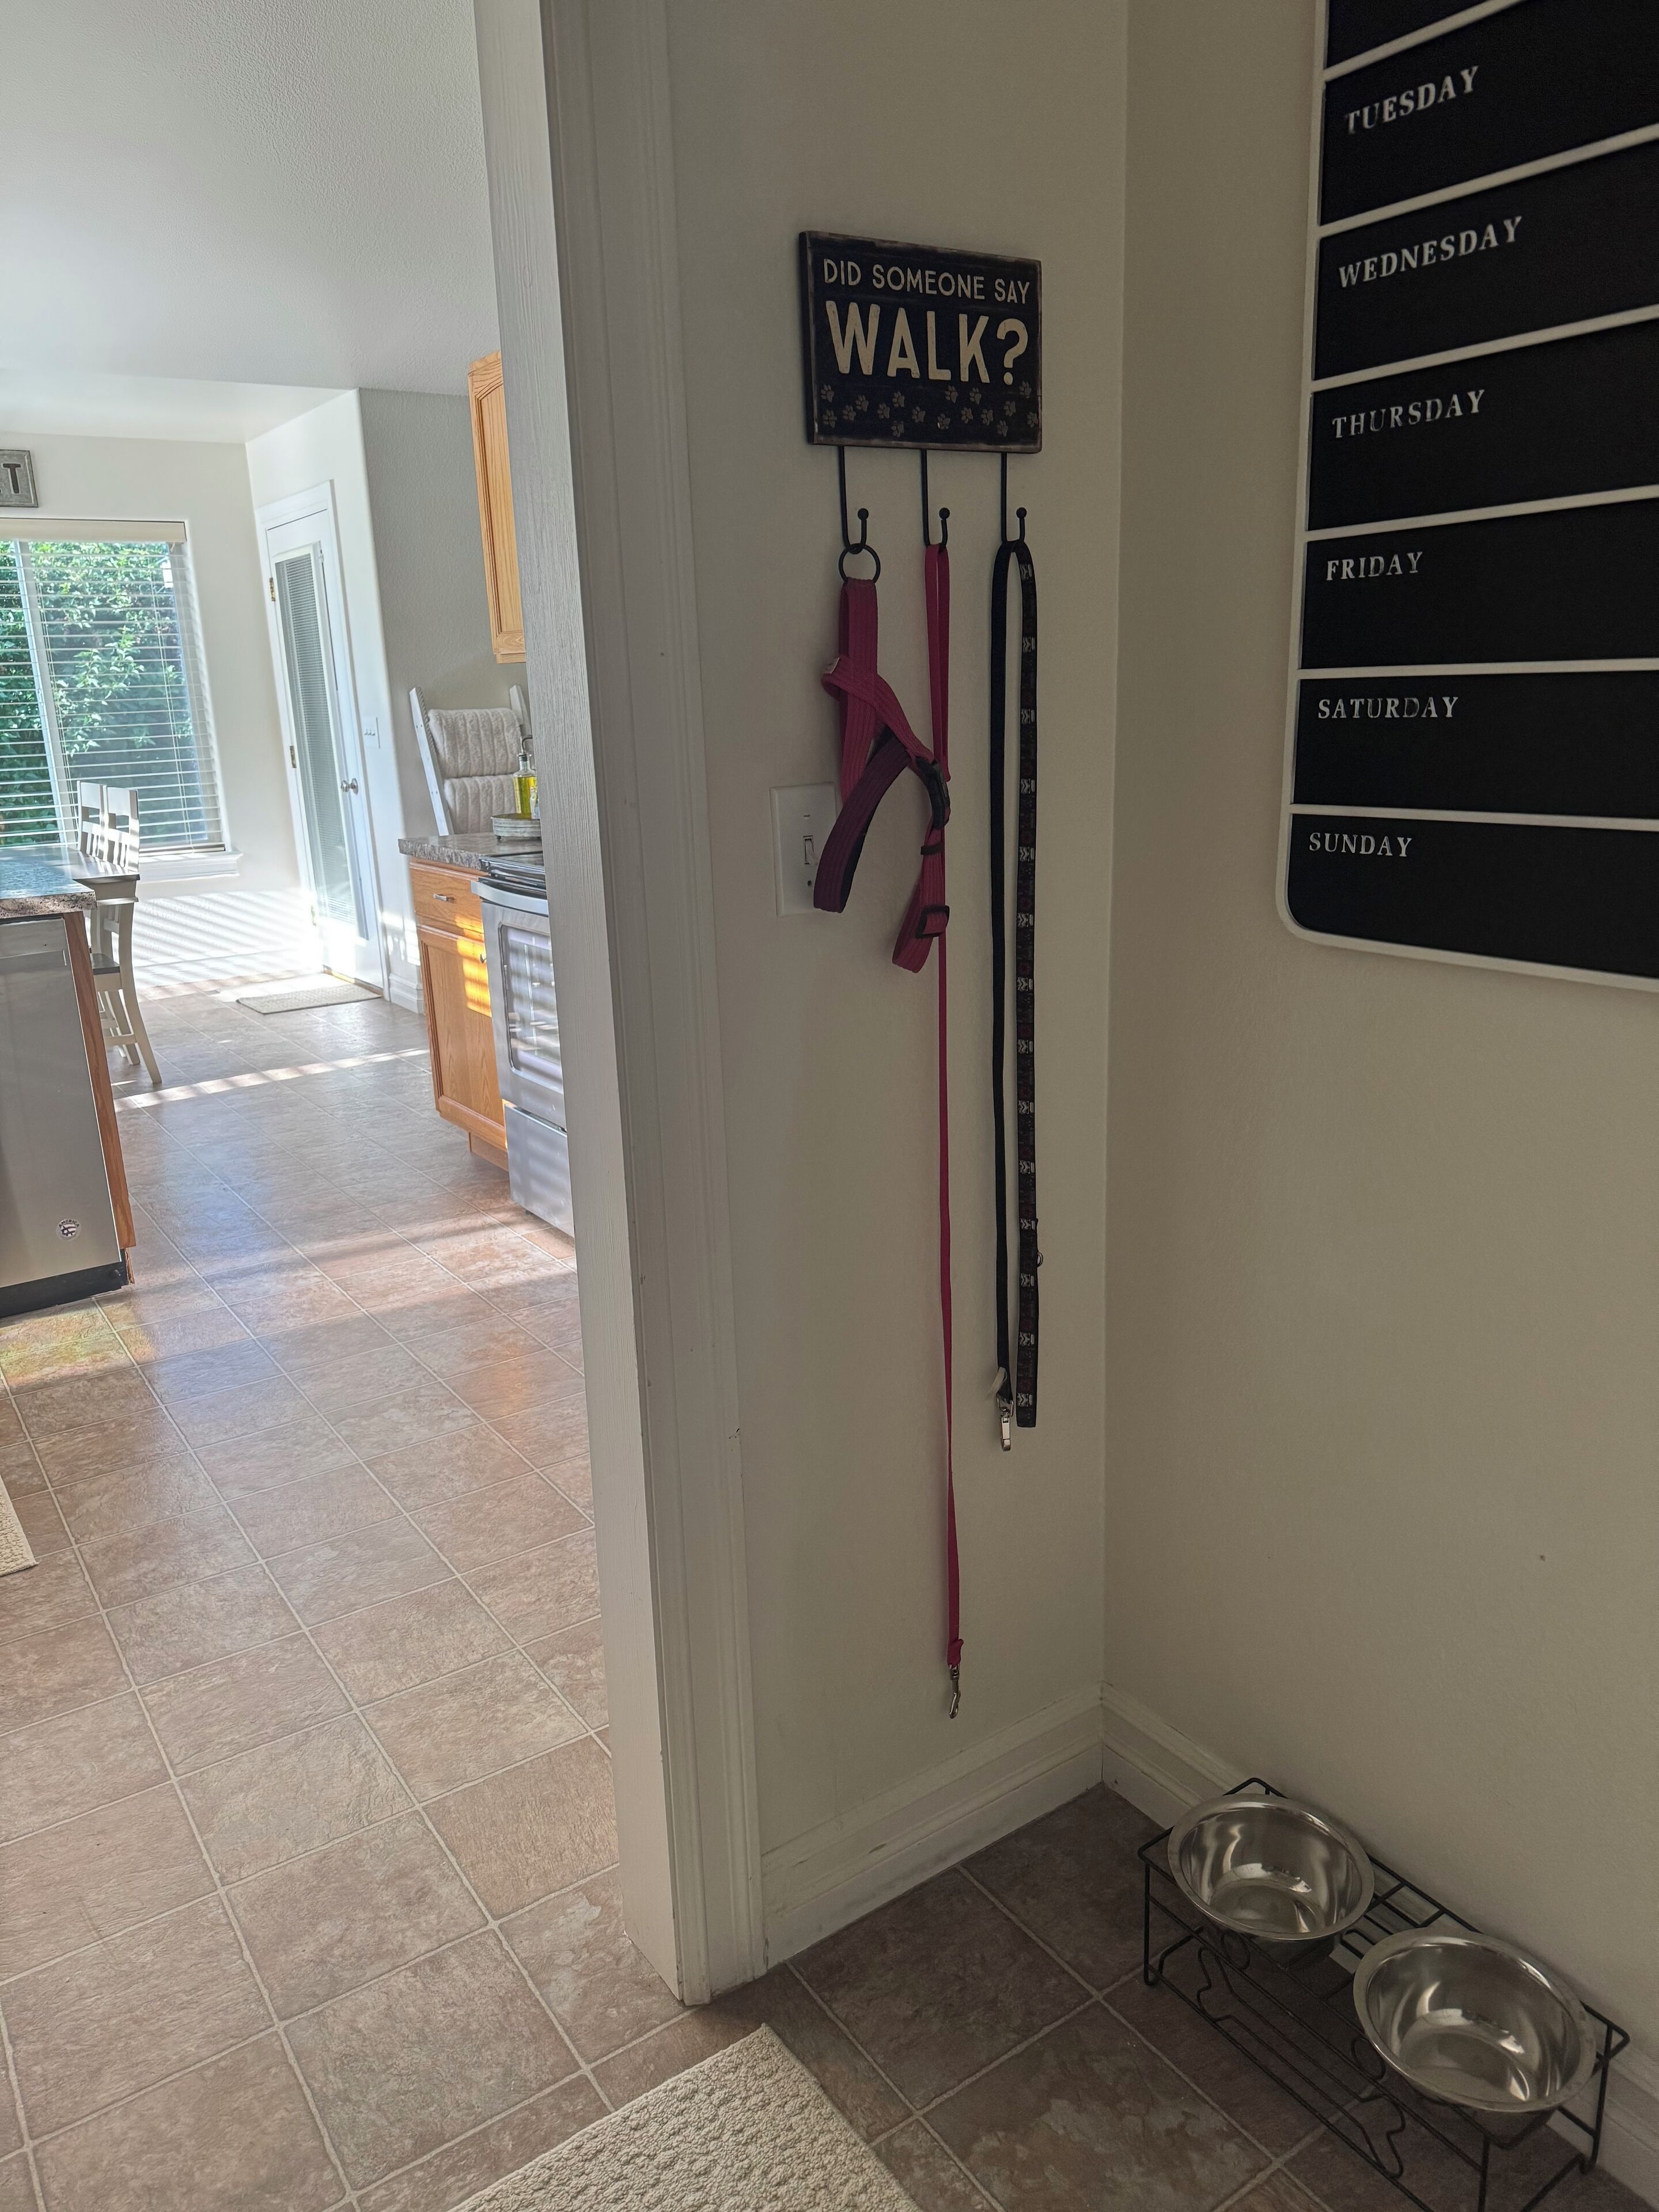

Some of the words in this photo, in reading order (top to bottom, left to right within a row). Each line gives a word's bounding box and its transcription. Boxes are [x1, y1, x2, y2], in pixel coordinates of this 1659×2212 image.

[1345, 66, 1479, 134] TUESDAY
[1338, 216, 1522, 287] WEDNESDAY
[824, 259, 861, 285] DID
[872, 264, 984, 299] SOMEONE
[995, 279, 1029, 304] SAY
[825, 300, 1028, 385] WALK?
[1332, 389, 1485, 438] THURSDAY
[0, 463, 21, 494] T
[1326, 551, 1423, 581] FRIDAY
[1319, 696, 1458, 718] SATURDAY
[1309, 832, 1412, 857] SUNDAY
[59, 1219, 79, 1228] AMERICA
